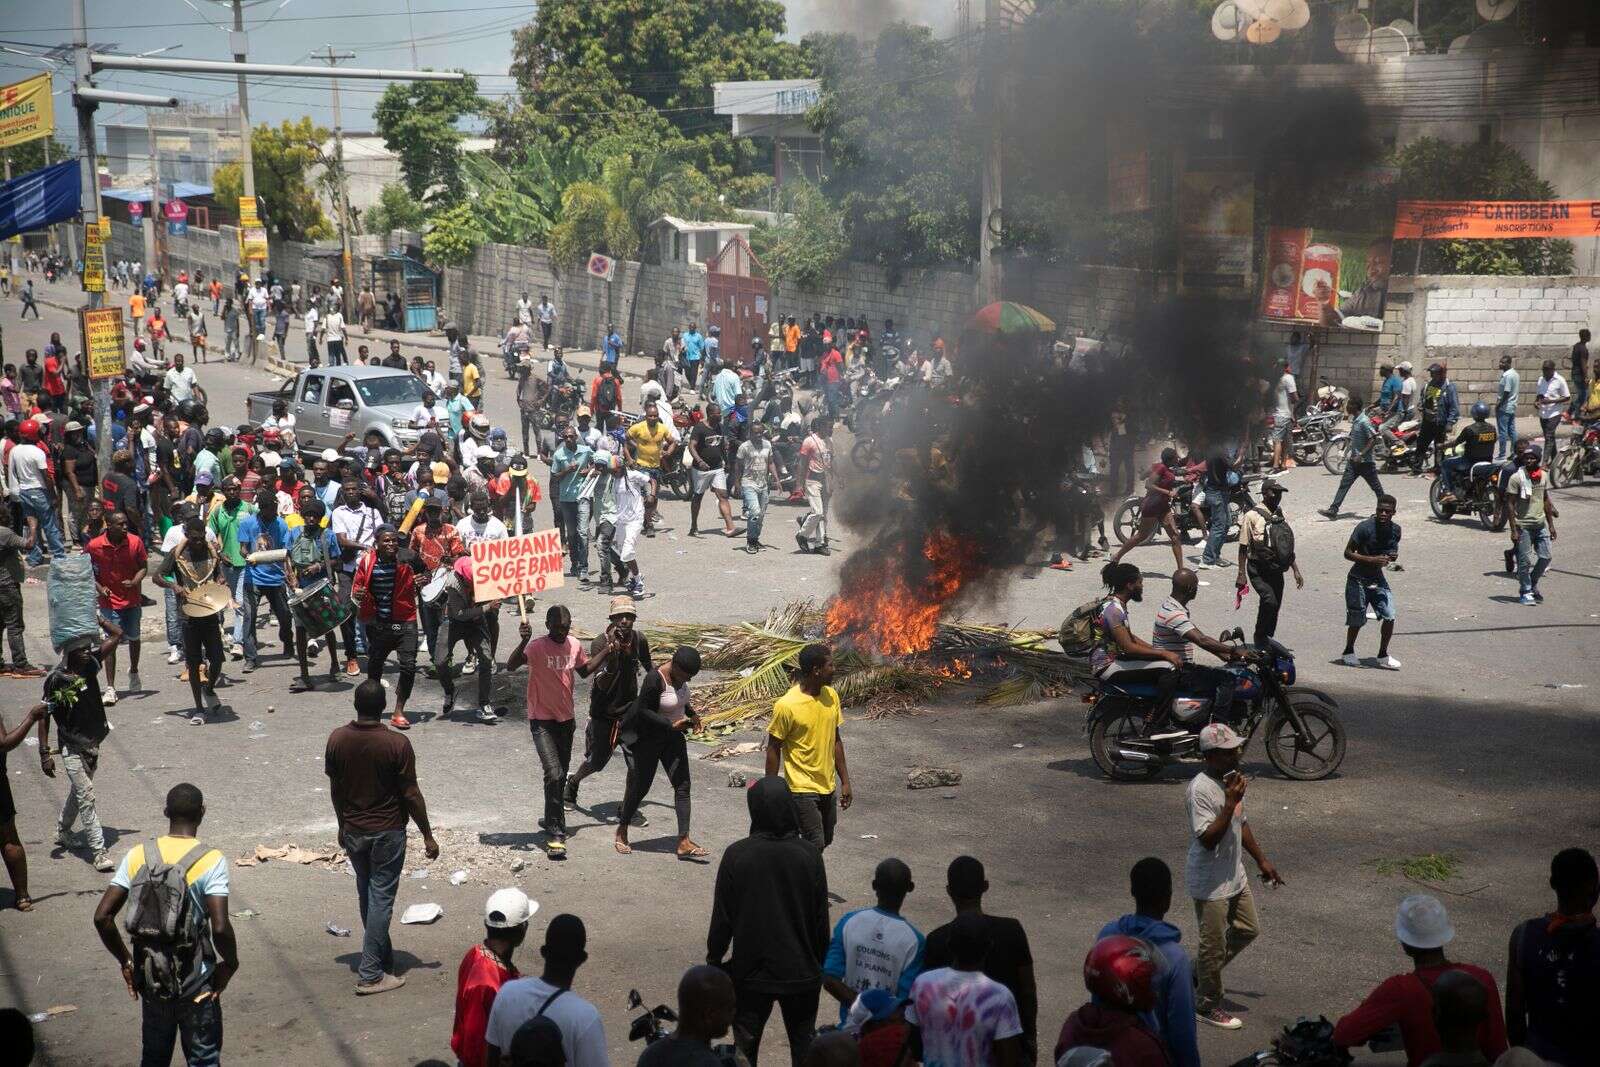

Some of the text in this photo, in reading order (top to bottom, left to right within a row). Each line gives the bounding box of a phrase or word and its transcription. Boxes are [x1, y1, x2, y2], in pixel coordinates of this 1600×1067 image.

[1484, 203, 1569, 220] CARIBBEAN
[1495, 222, 1553, 232] INSCRIPTIONS
[473, 533, 561, 563] UNIBANK
